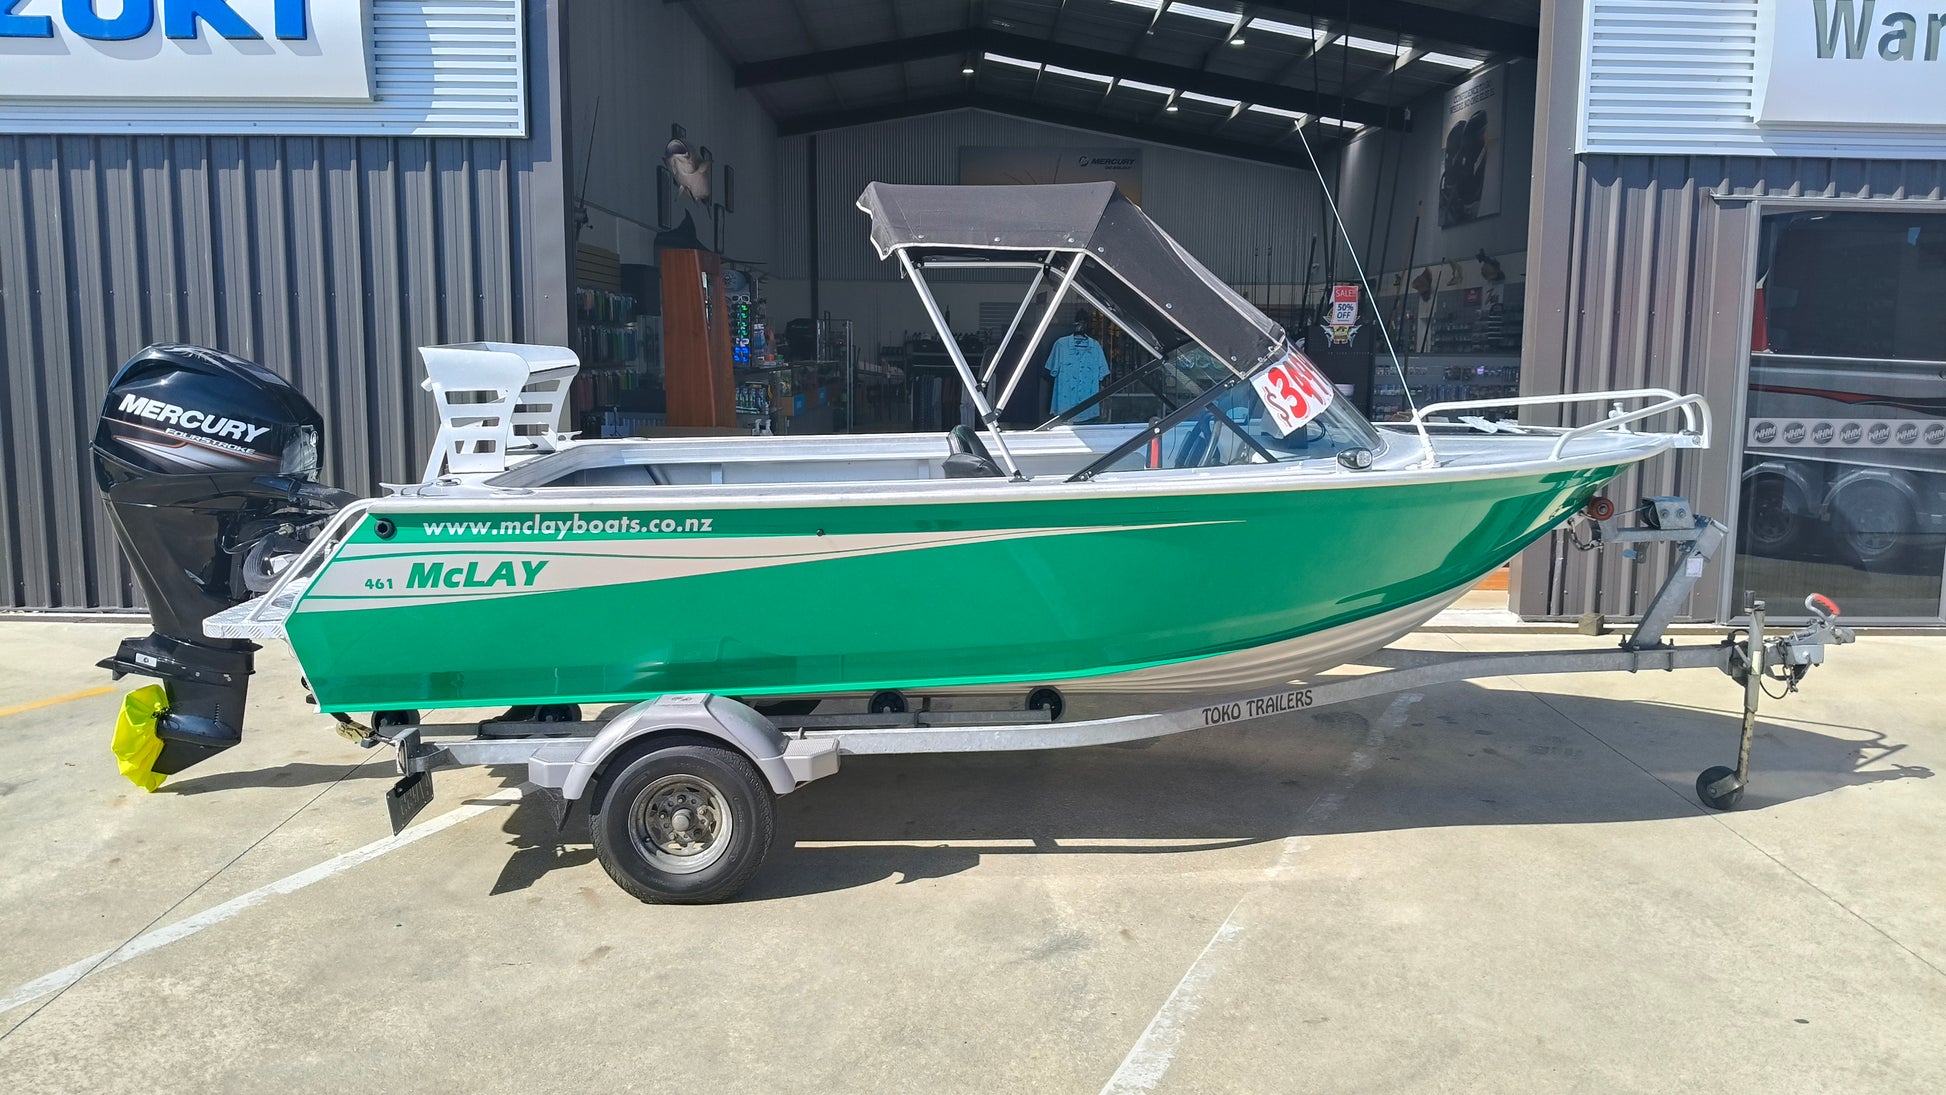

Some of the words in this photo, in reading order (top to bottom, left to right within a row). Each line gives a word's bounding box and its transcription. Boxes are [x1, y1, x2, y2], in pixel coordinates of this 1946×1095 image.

[1337, 303, 1354, 311] 50%
[1336, 311, 1351, 319] OFF
[118, 394, 270, 443] MERCURY
[1754, 426, 1776, 440] WHM
[1783, 426, 1806, 440] WHM
[1812, 426, 1834, 440] WHM
[1840, 426, 1862, 440] WHM
[1868, 426, 1890, 440] WHM
[1896, 426, 1918, 440] WHM
[1924, 426, 1946, 440] WHM
[165, 427, 255, 455] FOURSTROKE
[423, 513, 714, 539] www.mclayboats.co.nz
[364, 578, 394, 590] 461
[406, 561, 549, 589] McLAY
[1202, 703, 1241, 725] TOKO
[1246, 690, 1313, 717] TRAILERS
